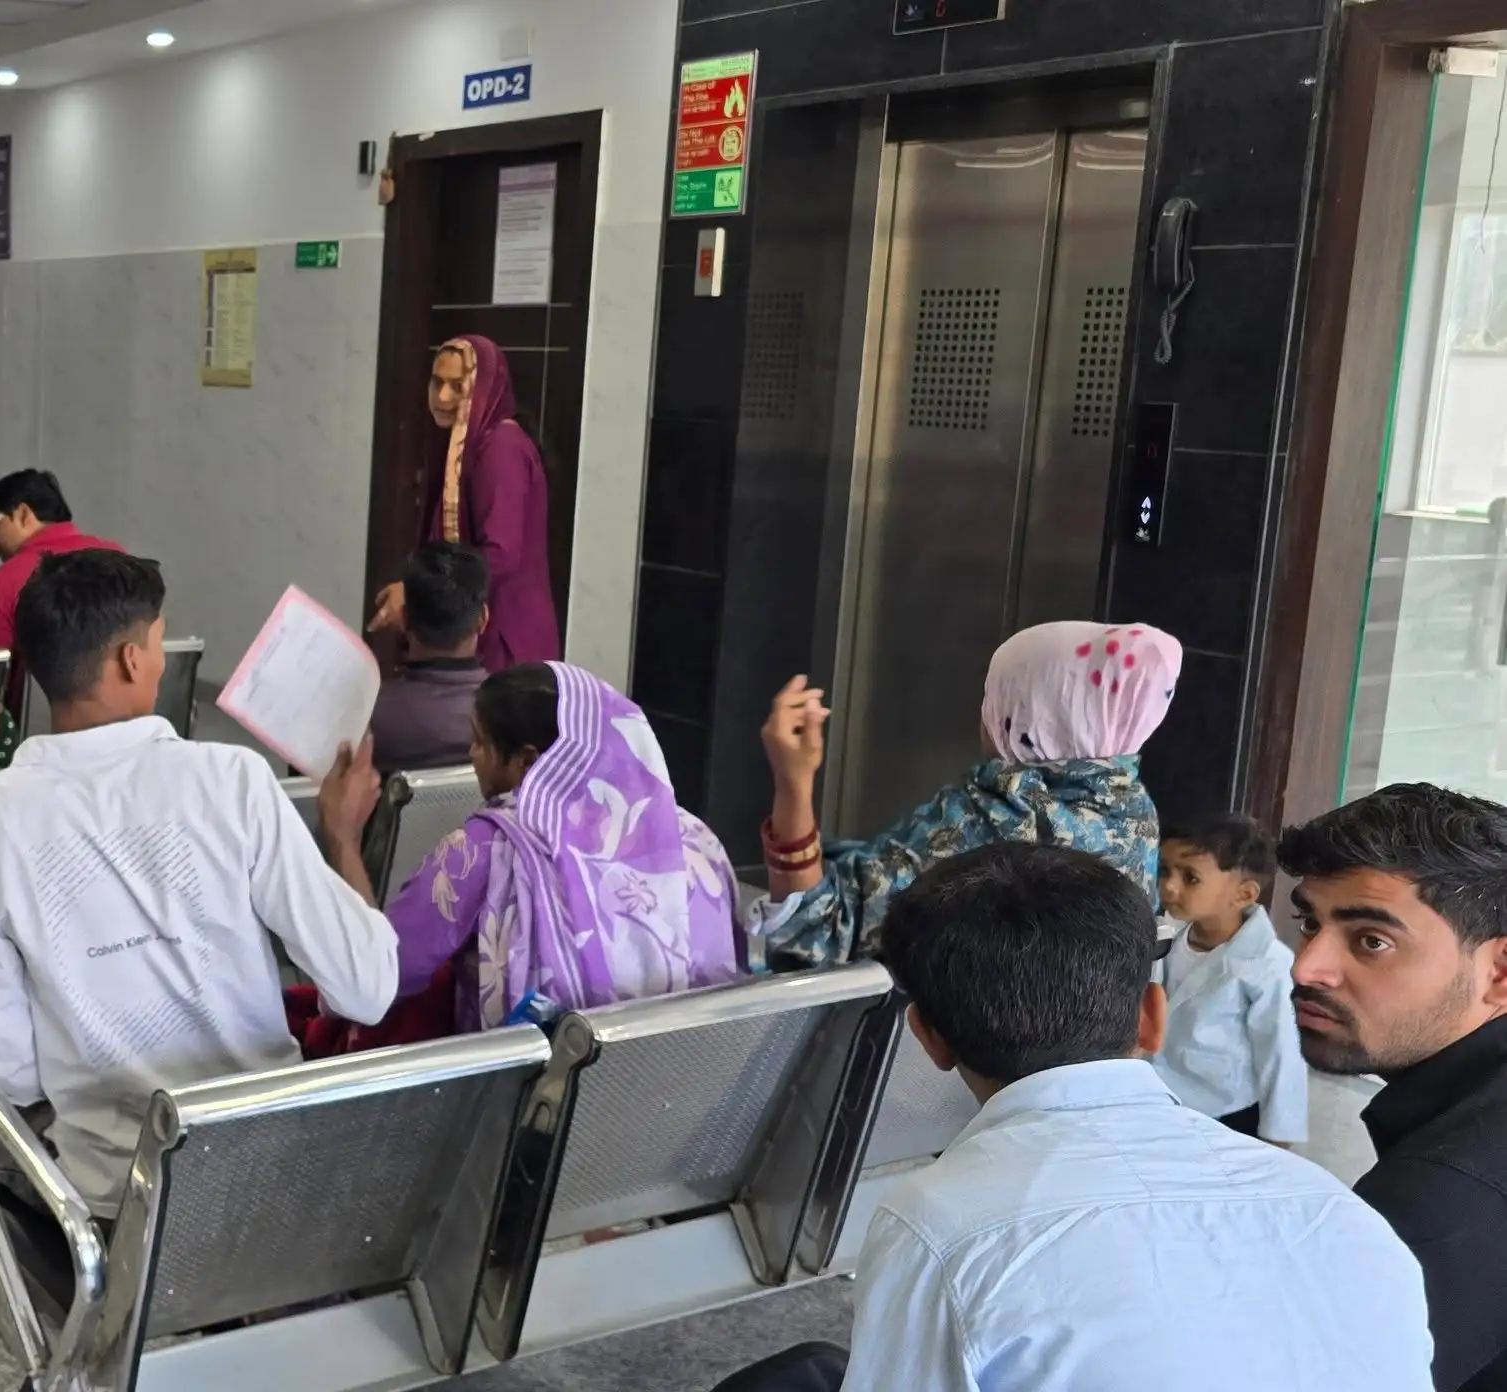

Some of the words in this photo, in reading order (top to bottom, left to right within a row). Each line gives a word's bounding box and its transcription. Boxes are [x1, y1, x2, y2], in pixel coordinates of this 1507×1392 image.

[467, 72, 525, 102] OPD-2
[86, 942, 125, 958] Calvin
[125, 934, 151, 948] Klein
